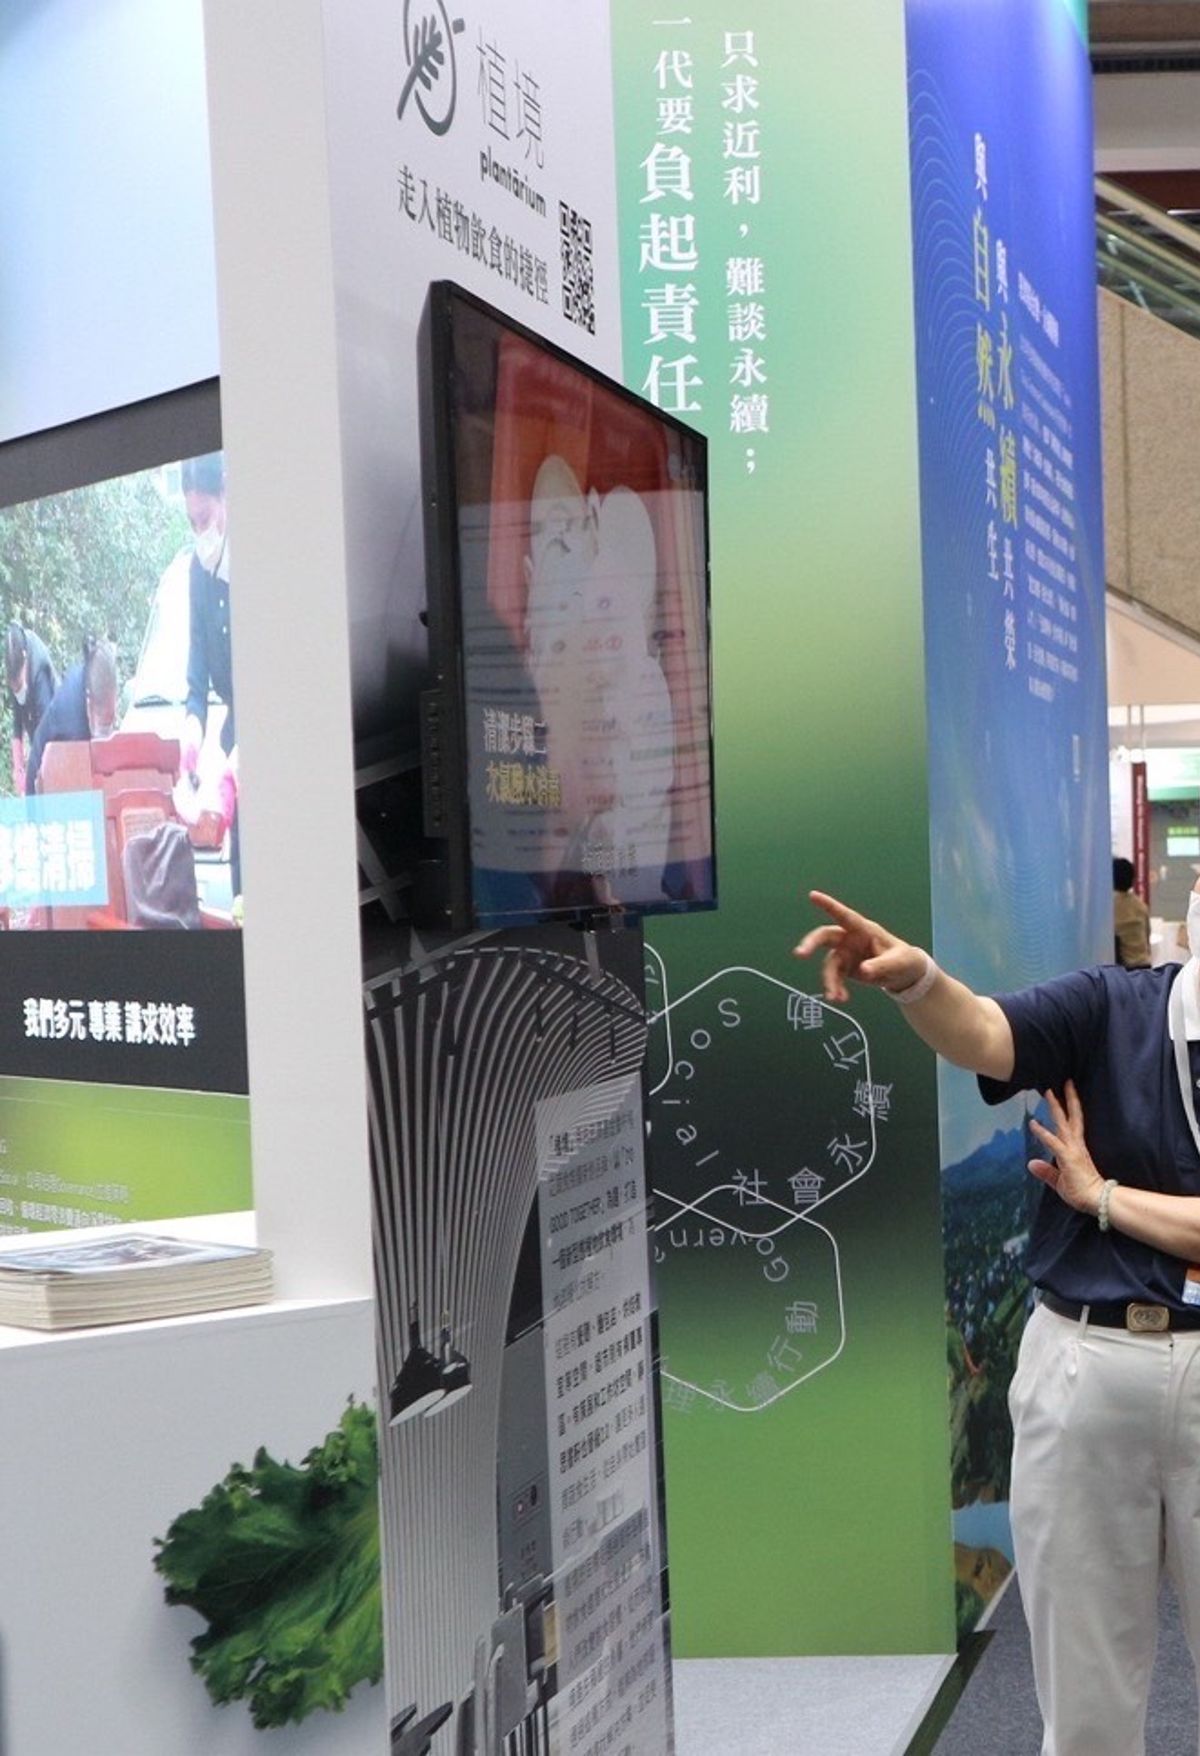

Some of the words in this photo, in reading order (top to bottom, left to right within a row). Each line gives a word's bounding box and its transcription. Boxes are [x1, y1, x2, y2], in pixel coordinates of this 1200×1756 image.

[397, 163, 551, 306] 走入植物飲食的捷徑
[476, 28, 546, 170] 植境
[638, 14, 704, 414] 一代要負起責任
[719, 29, 771, 476] 只求近利，難談永續；
